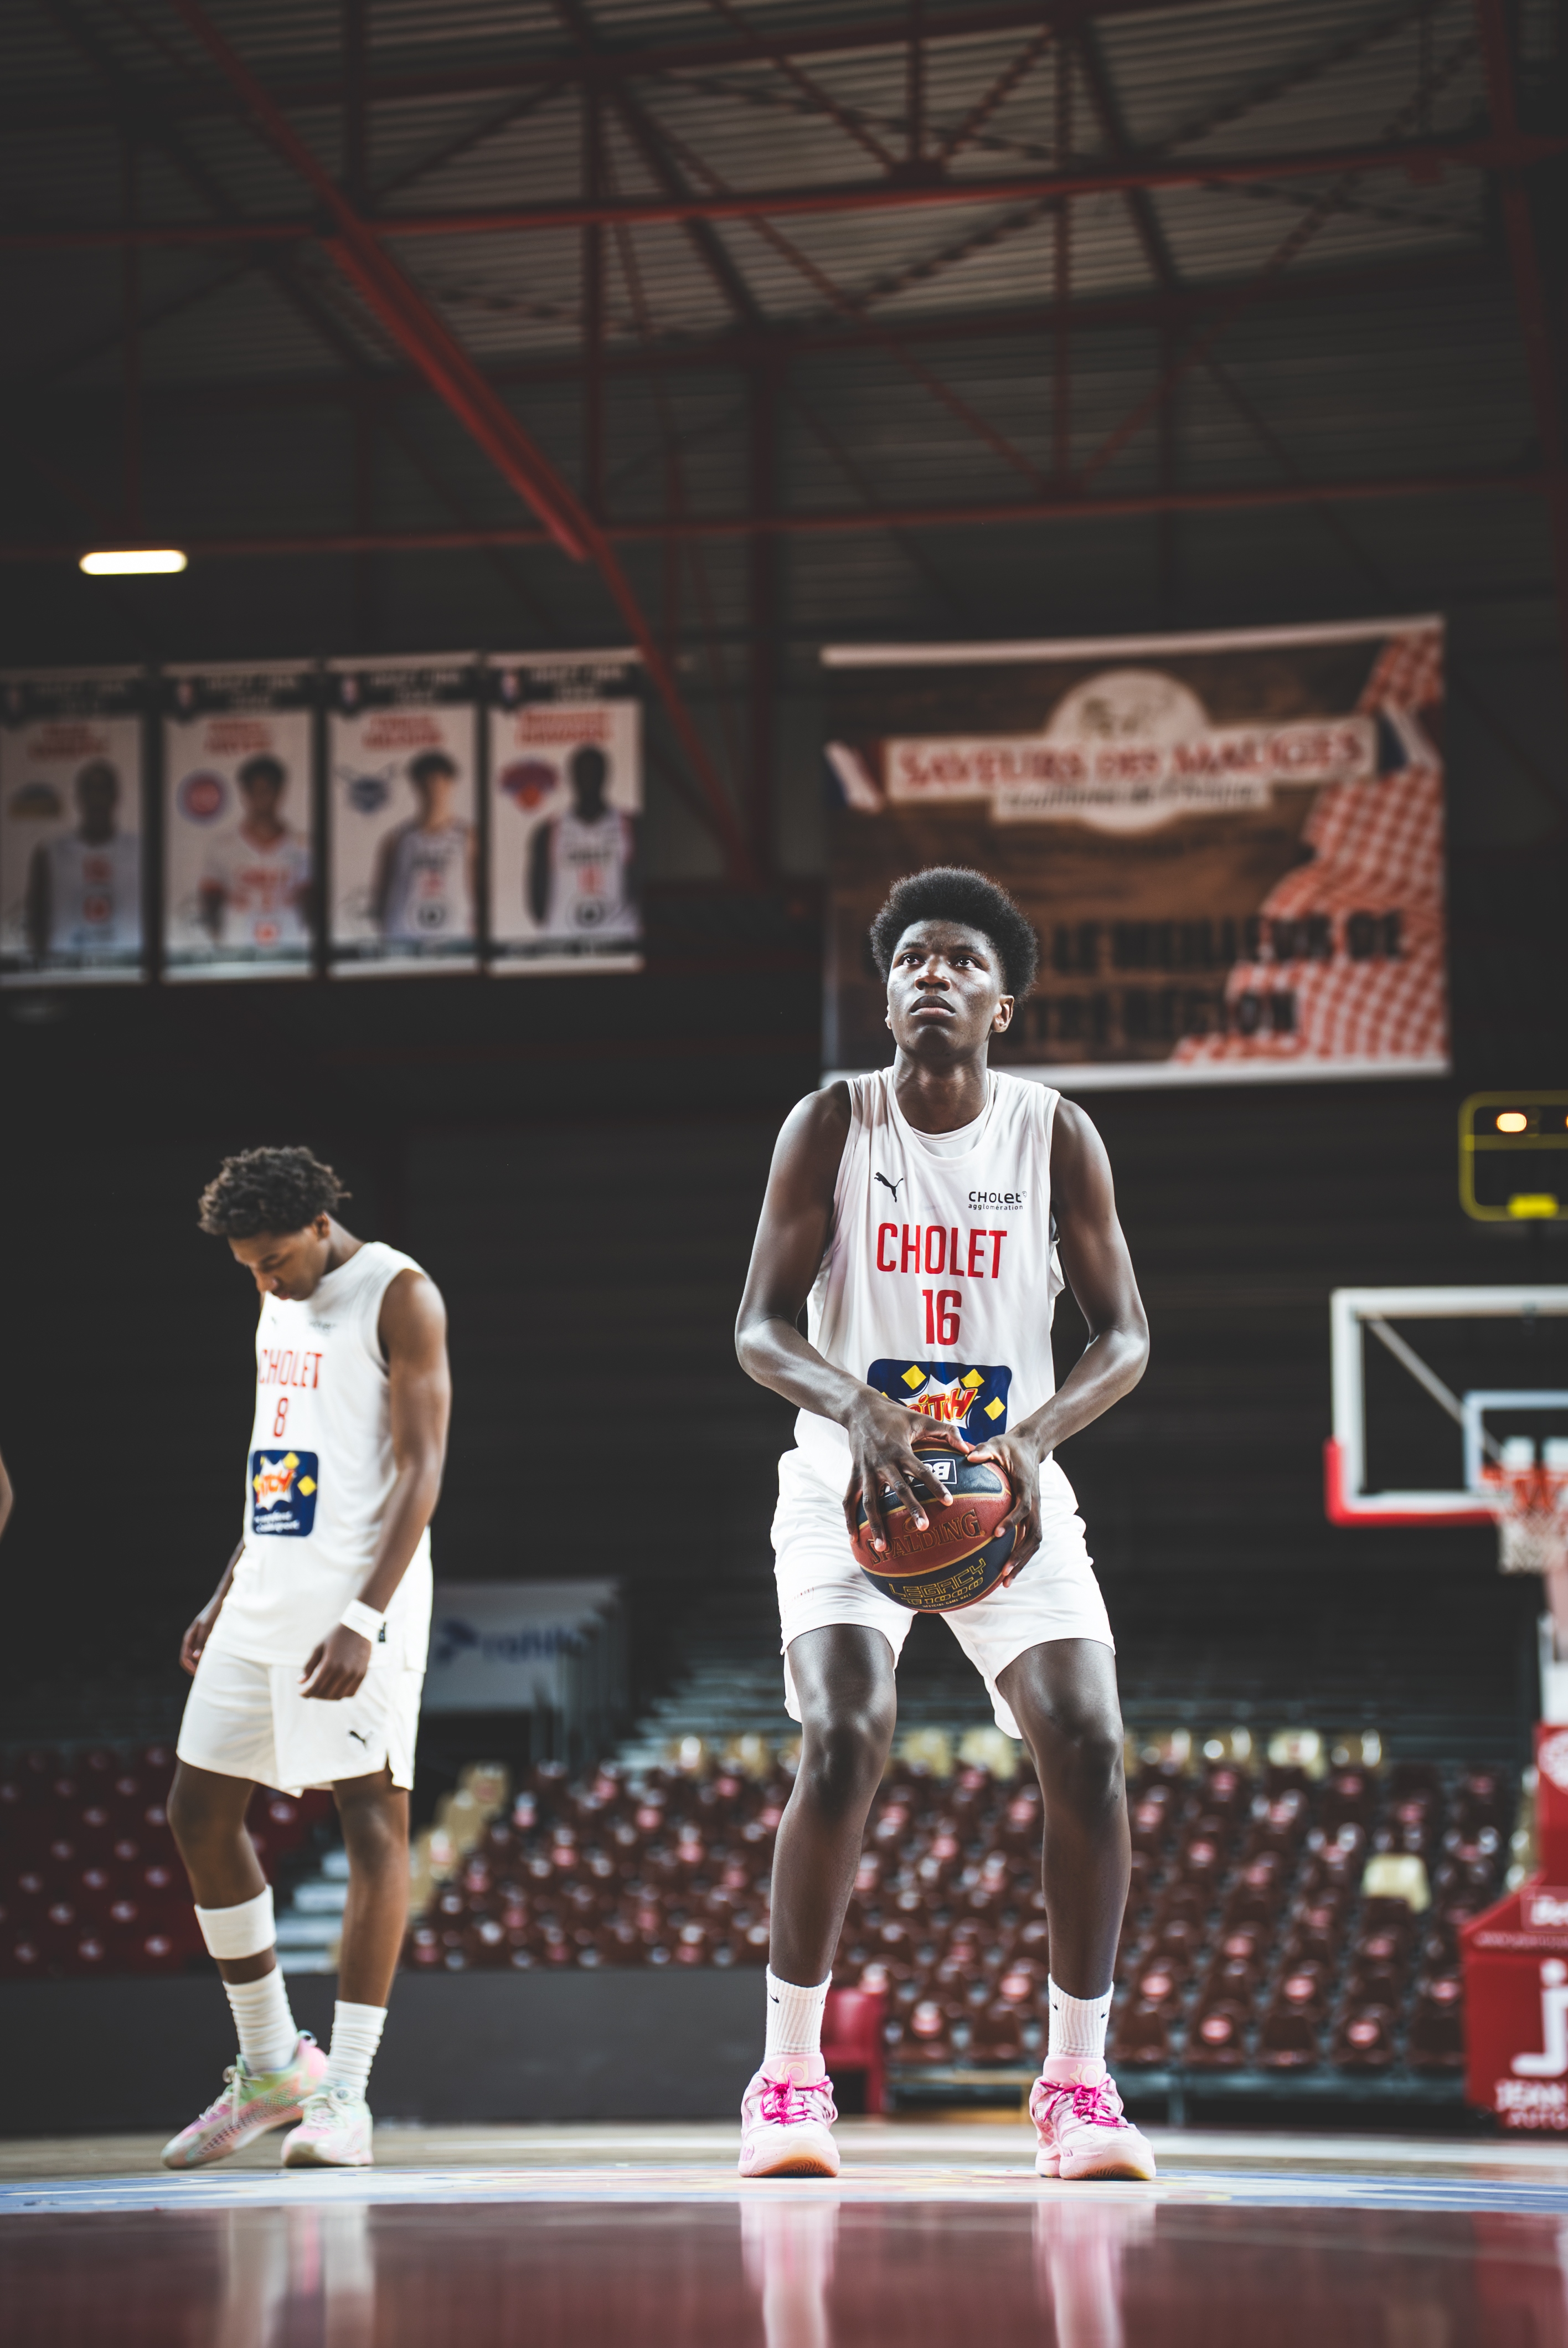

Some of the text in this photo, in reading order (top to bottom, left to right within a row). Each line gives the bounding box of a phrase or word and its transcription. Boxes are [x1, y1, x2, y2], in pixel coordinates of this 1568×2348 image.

[876, 1222, 1007, 1279] CHOLET
[922, 1289, 962, 1346] 16
[259, 1349, 323, 1389] CHOLET
[273, 1397, 288, 1437] 8
[866, 1508, 981, 1567] SPALDING
[889, 1558, 987, 1598] LEGACY
